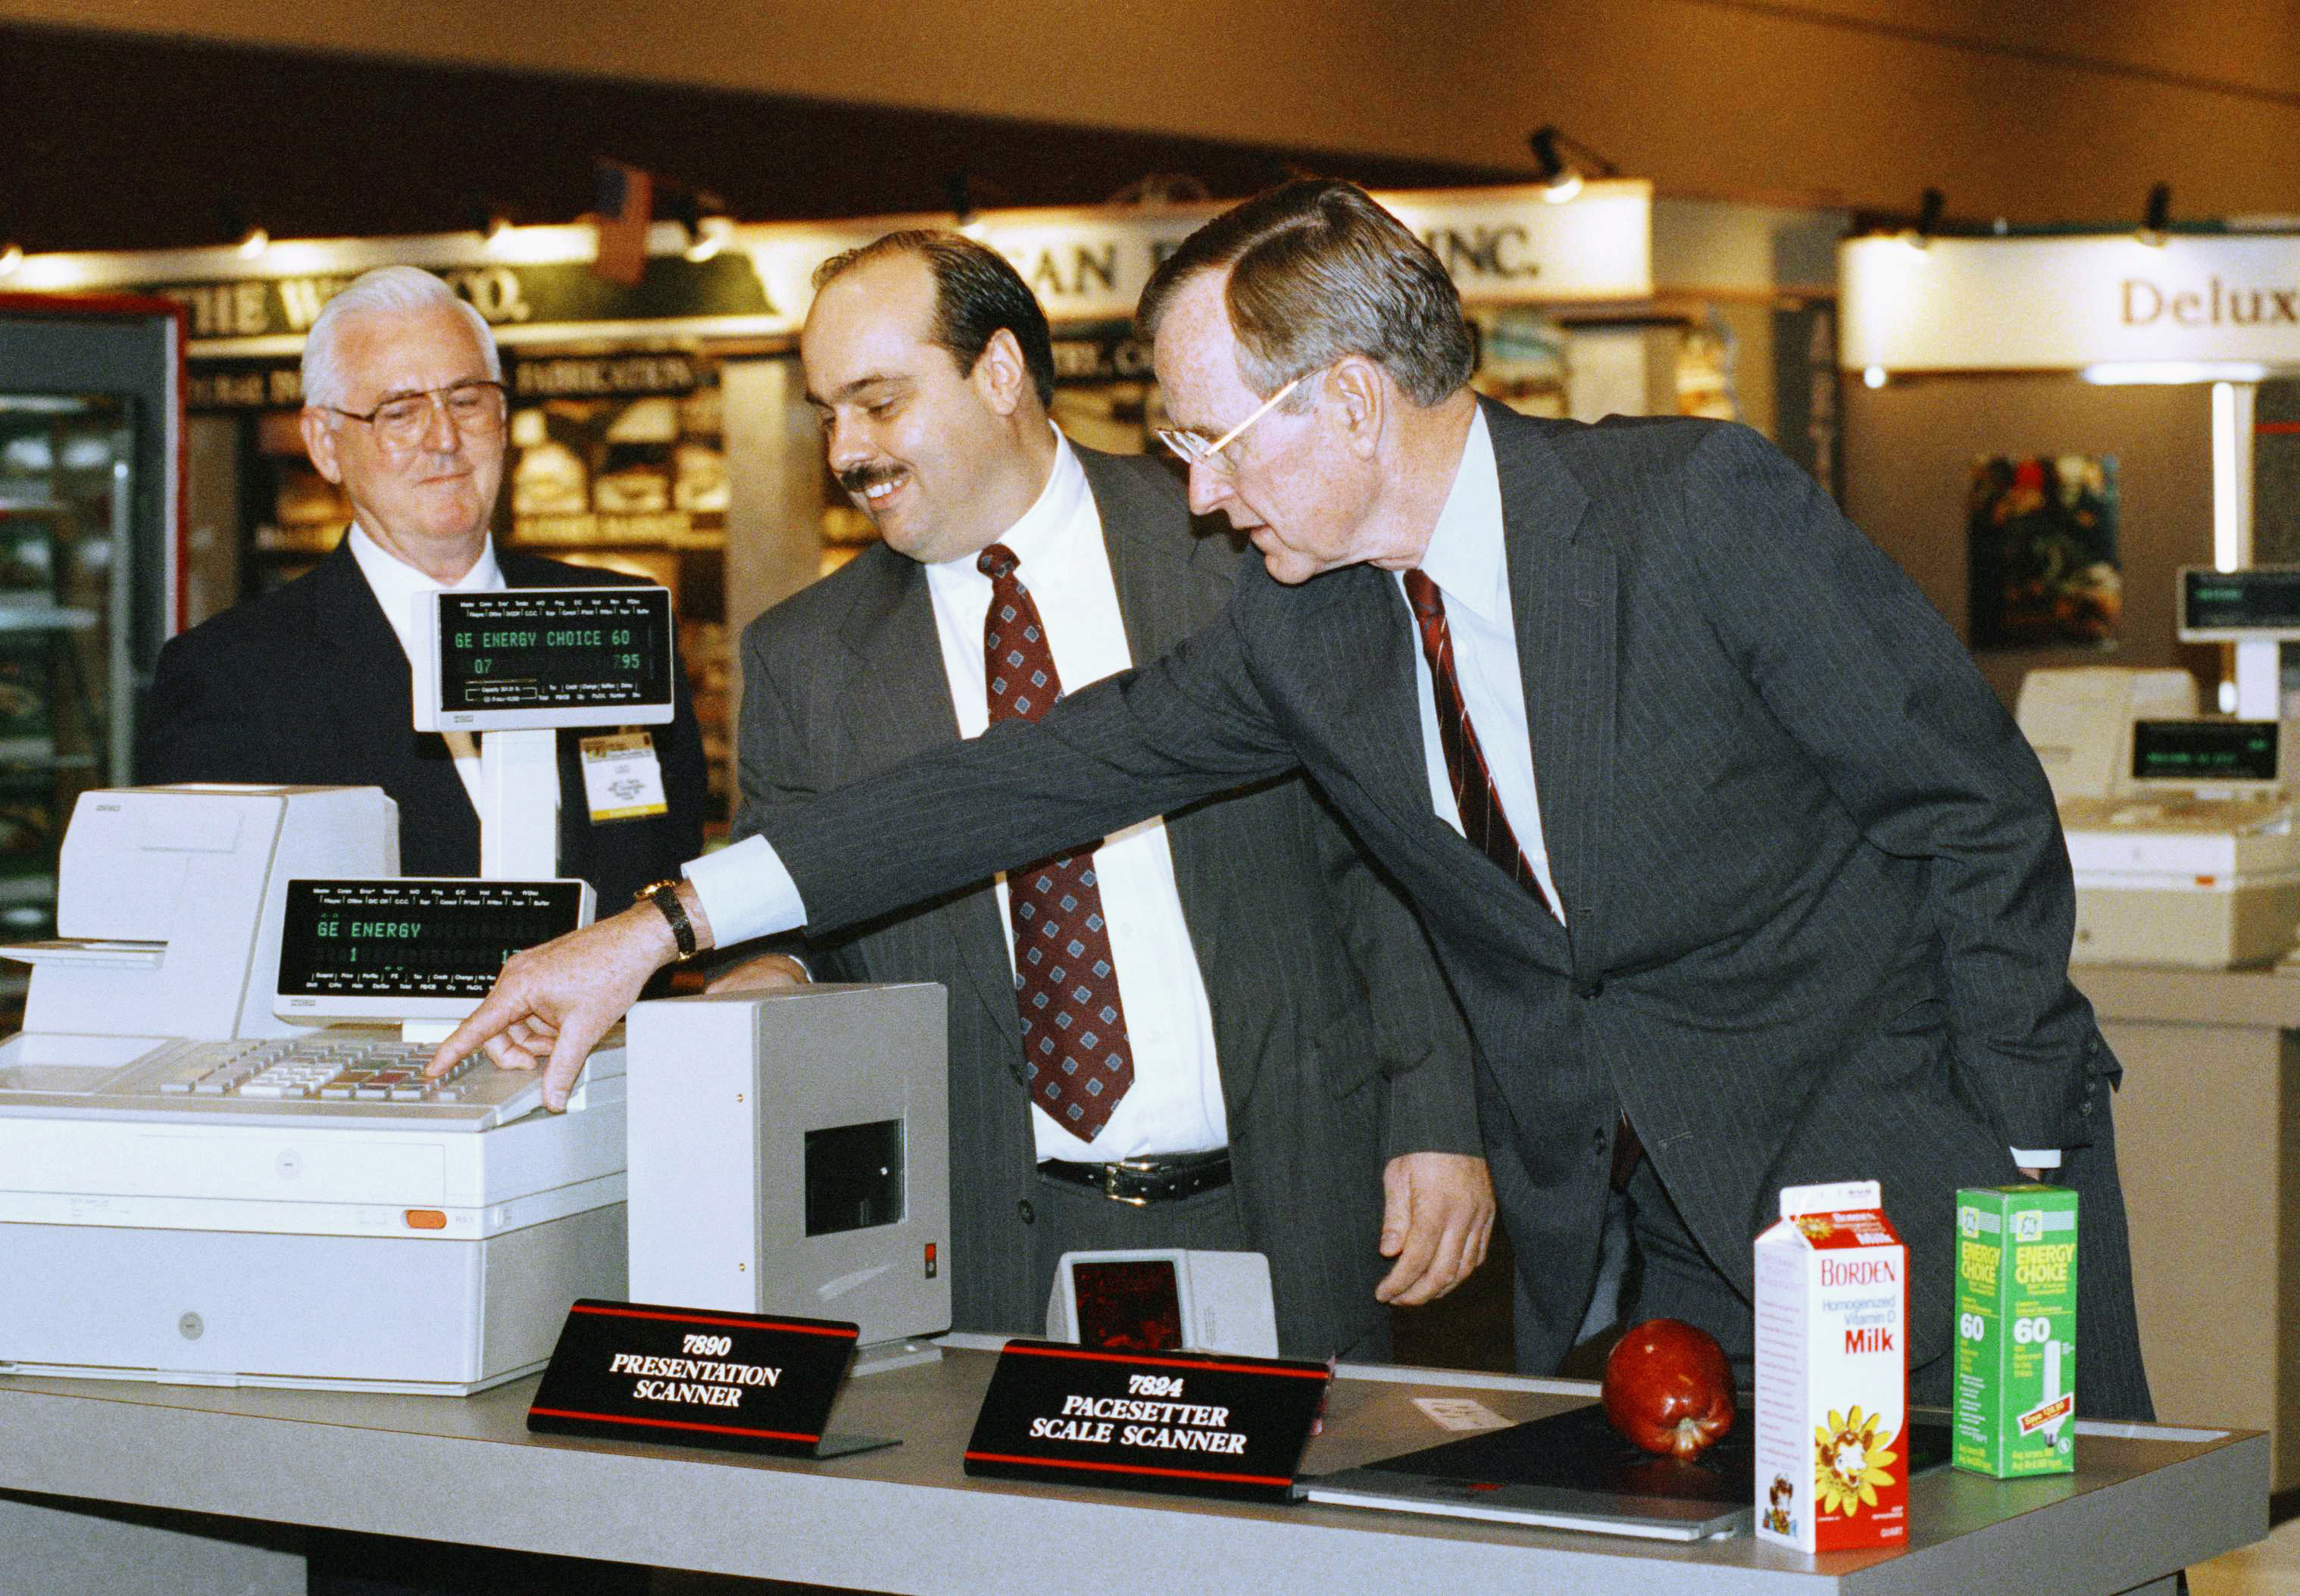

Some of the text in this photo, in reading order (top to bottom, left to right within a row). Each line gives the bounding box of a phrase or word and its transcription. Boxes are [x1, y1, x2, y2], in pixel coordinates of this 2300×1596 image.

[455, 629, 630, 648] GE ENERGY CHOICE 60
[317, 921, 421, 939] GE ENERGY
[350, 947, 357, 963] 1
[1961, 1241, 2001, 1266] ENERGY
[2016, 1245, 2076, 1266] ENERGY
[1961, 1260, 1996, 1285] CHOICE
[2015, 1263, 2067, 1285] CHOICE
[1961, 1313, 1984, 1341] 60
[2013, 1316, 2051, 1345] 60
[683, 1334, 732, 1357] 7890
[1845, 1326, 1895, 1354] Milk
[609, 1353, 782, 1388] PRESENTATION
[633, 1379, 742, 1408] SCANNER
[1128, 1374, 1184, 1398] 7824
[1061, 1395, 1229, 1428] PACESETTER
[1030, 1417, 1247, 1455] SCALE SCANNER
